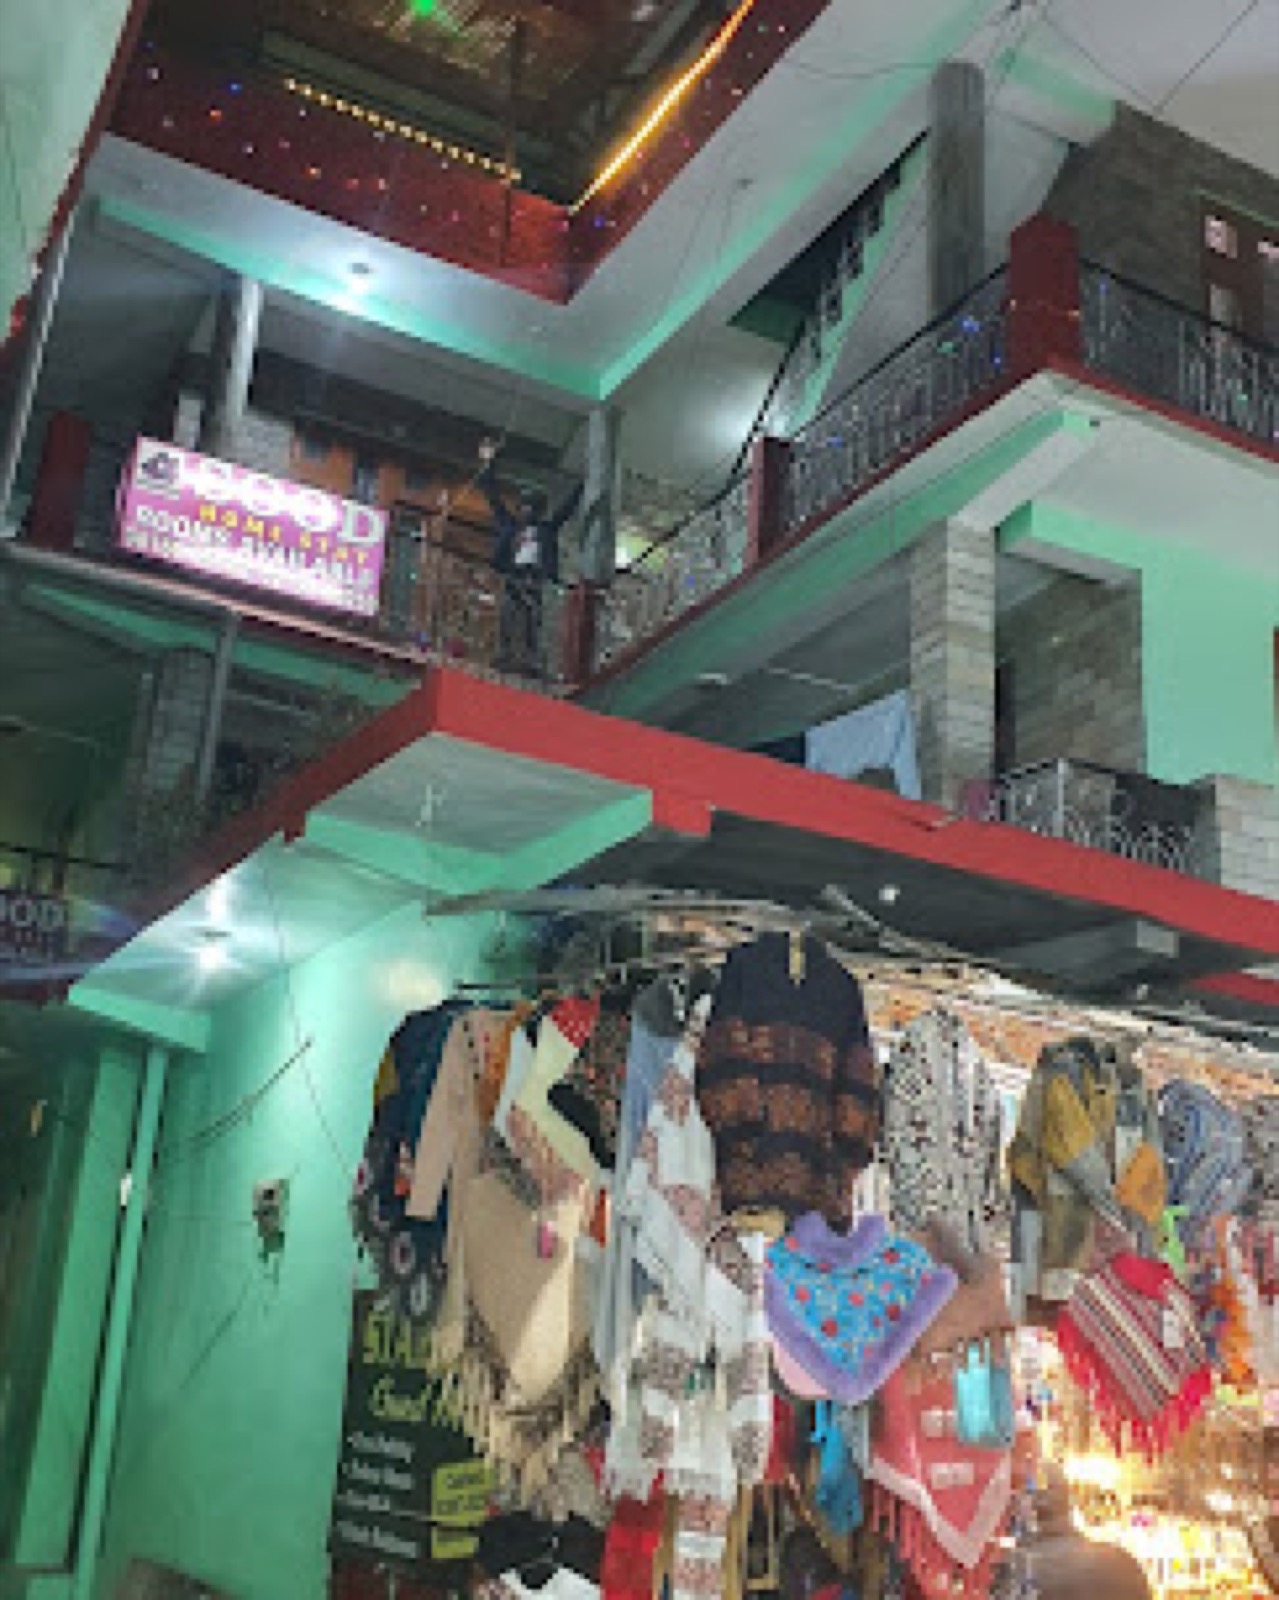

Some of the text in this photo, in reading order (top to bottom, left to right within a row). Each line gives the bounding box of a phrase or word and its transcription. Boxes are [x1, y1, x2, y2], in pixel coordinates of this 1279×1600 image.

[136, 505, 231, 547] ROOMS
[200, 499, 369, 566] HOME STAY
